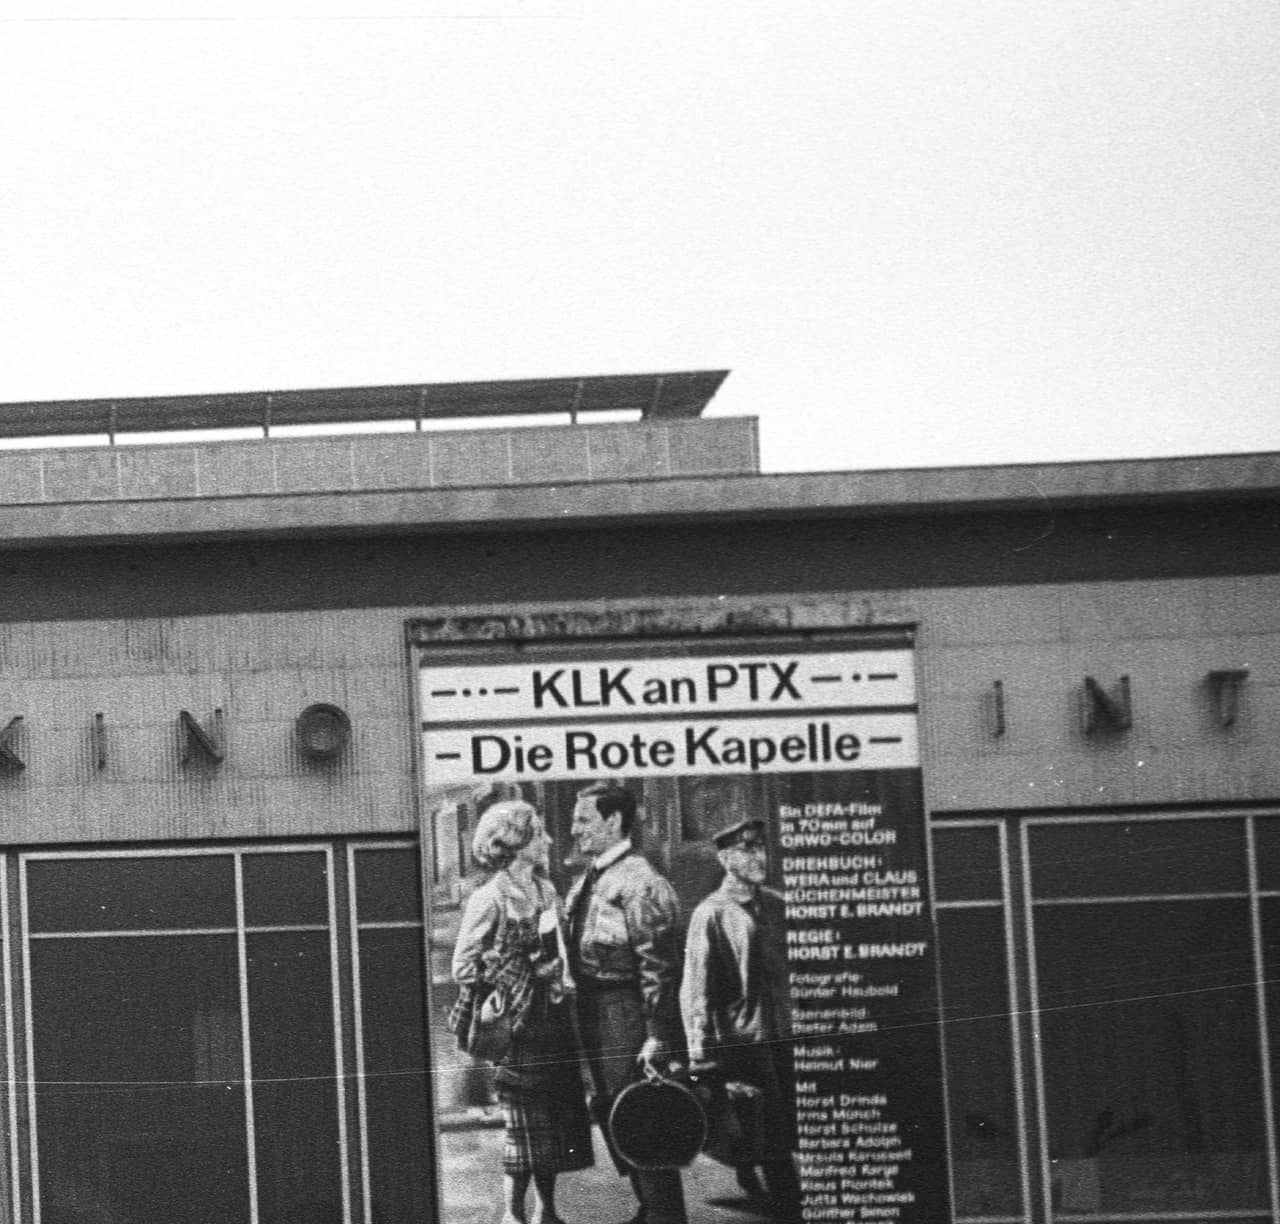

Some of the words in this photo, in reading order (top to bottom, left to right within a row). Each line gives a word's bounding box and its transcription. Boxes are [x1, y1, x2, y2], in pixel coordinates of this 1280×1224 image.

[532, 666, 636, 708] KLK
[642, 675, 697, 706] an
[707, 661, 802, 702] PTX
[471, 734, 553, 775] Die
[565, 731, 676, 771] Rote
[685, 722, 862, 770] Kapelle
[804, 802, 882, 817] DEFA-Film
[851, 816, 876, 829] auf
[780, 829, 897, 847] ORWO-COLOR
[832, 872, 859, 885] und
[863, 870, 918, 885] CLAUS
[784, 886, 920, 903] KÜCHENMEISTER
[785, 904, 837, 919] HORST
[841, 904, 854, 918] E.
[856, 902, 923, 918] BRANDT
[788, 945, 840, 960] HORST
[858, 942, 927, 958] BRANDT
[796, 1095, 834, 1108] Horst
